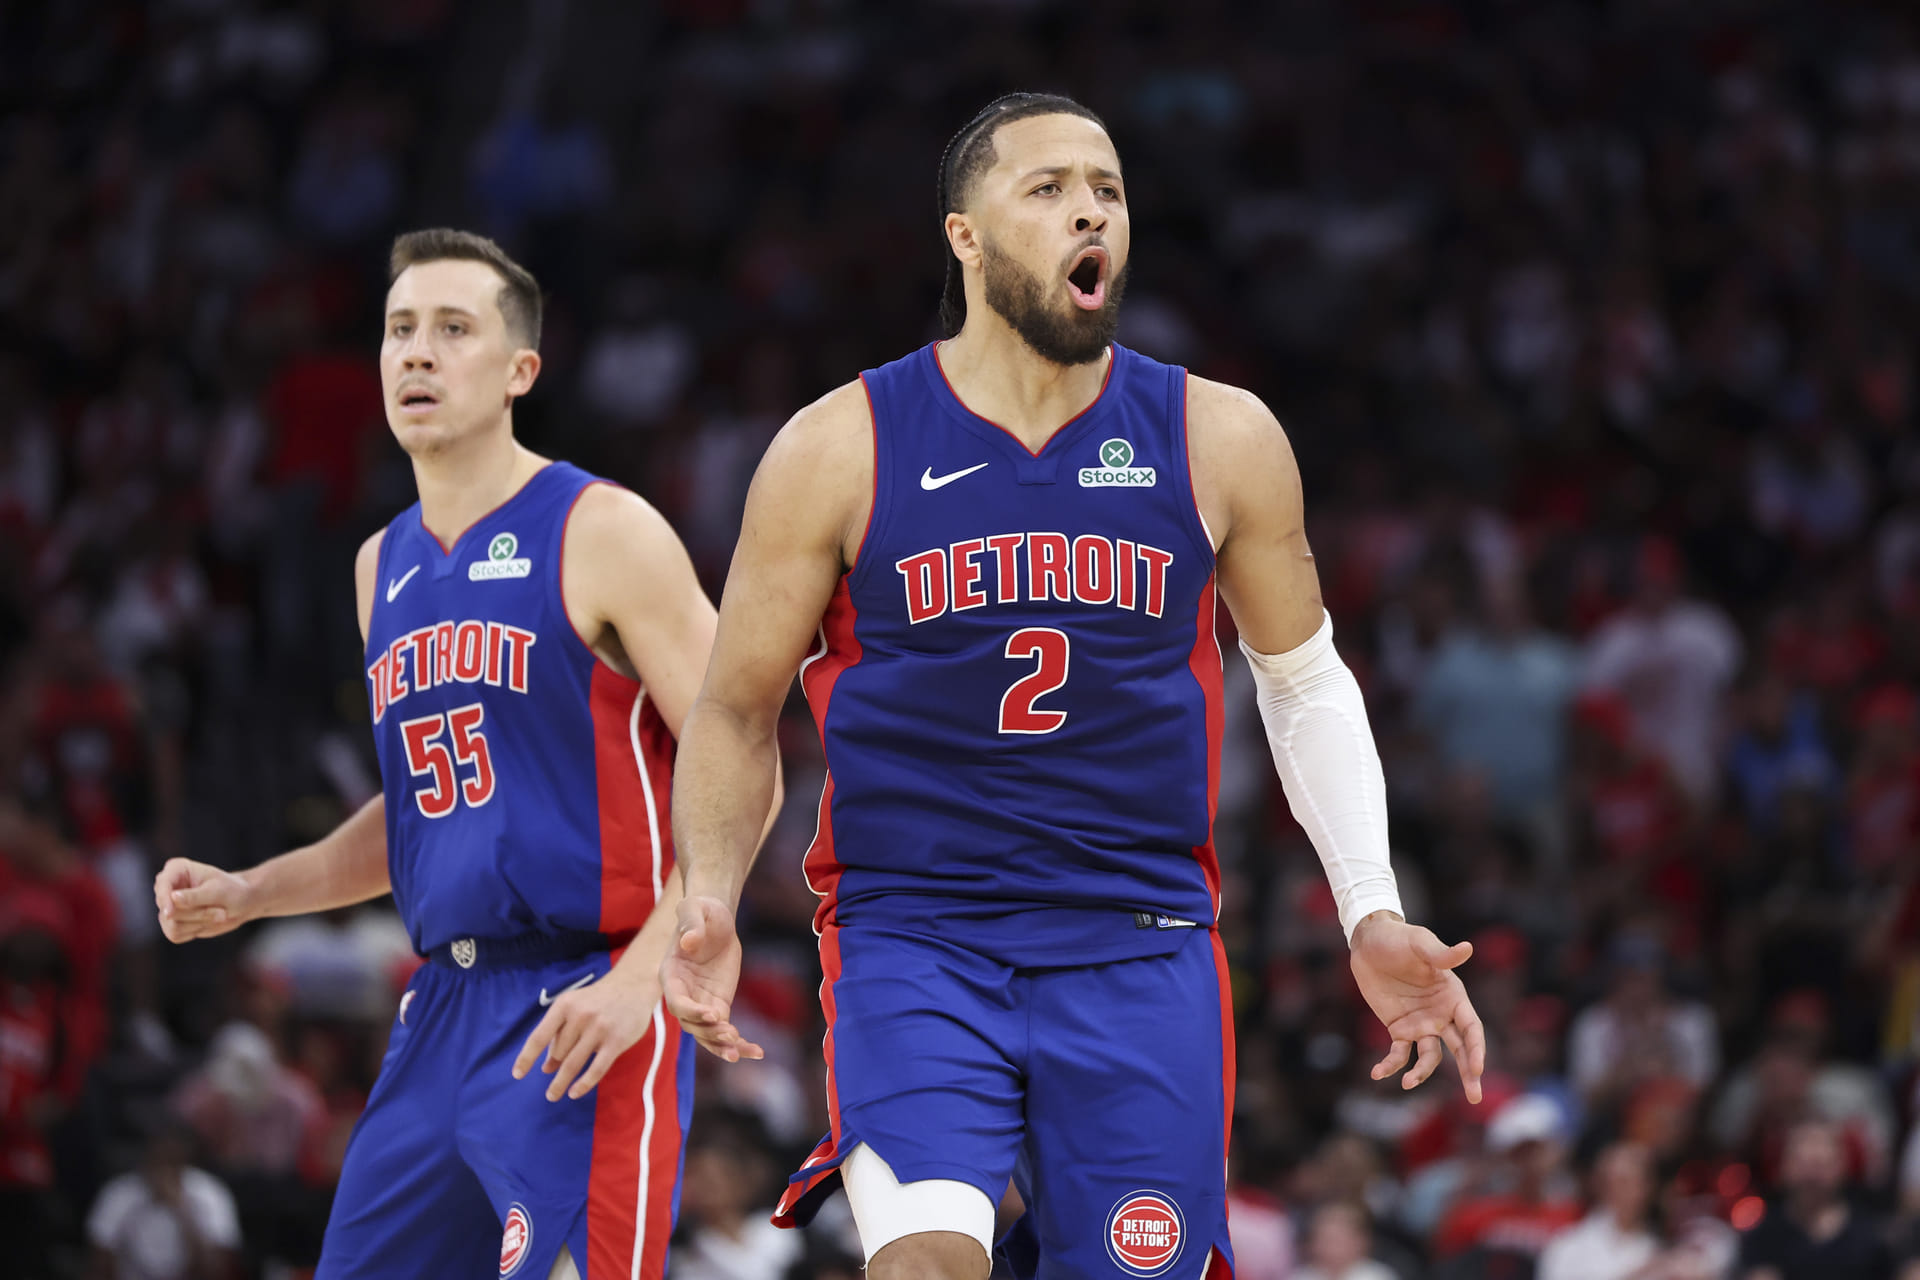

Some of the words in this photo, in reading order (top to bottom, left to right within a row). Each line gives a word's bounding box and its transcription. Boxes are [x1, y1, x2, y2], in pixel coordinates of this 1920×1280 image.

[1081, 470, 1153, 484] StockX
[896, 532, 1173, 625] DETROIT
[368, 620, 536, 725] DETROIT
[998, 627, 1070, 734] 2
[400, 702, 496, 819] 55
[1122, 1219, 1171, 1233] DETROIT
[1122, 1233, 1171, 1247] PISTONS
